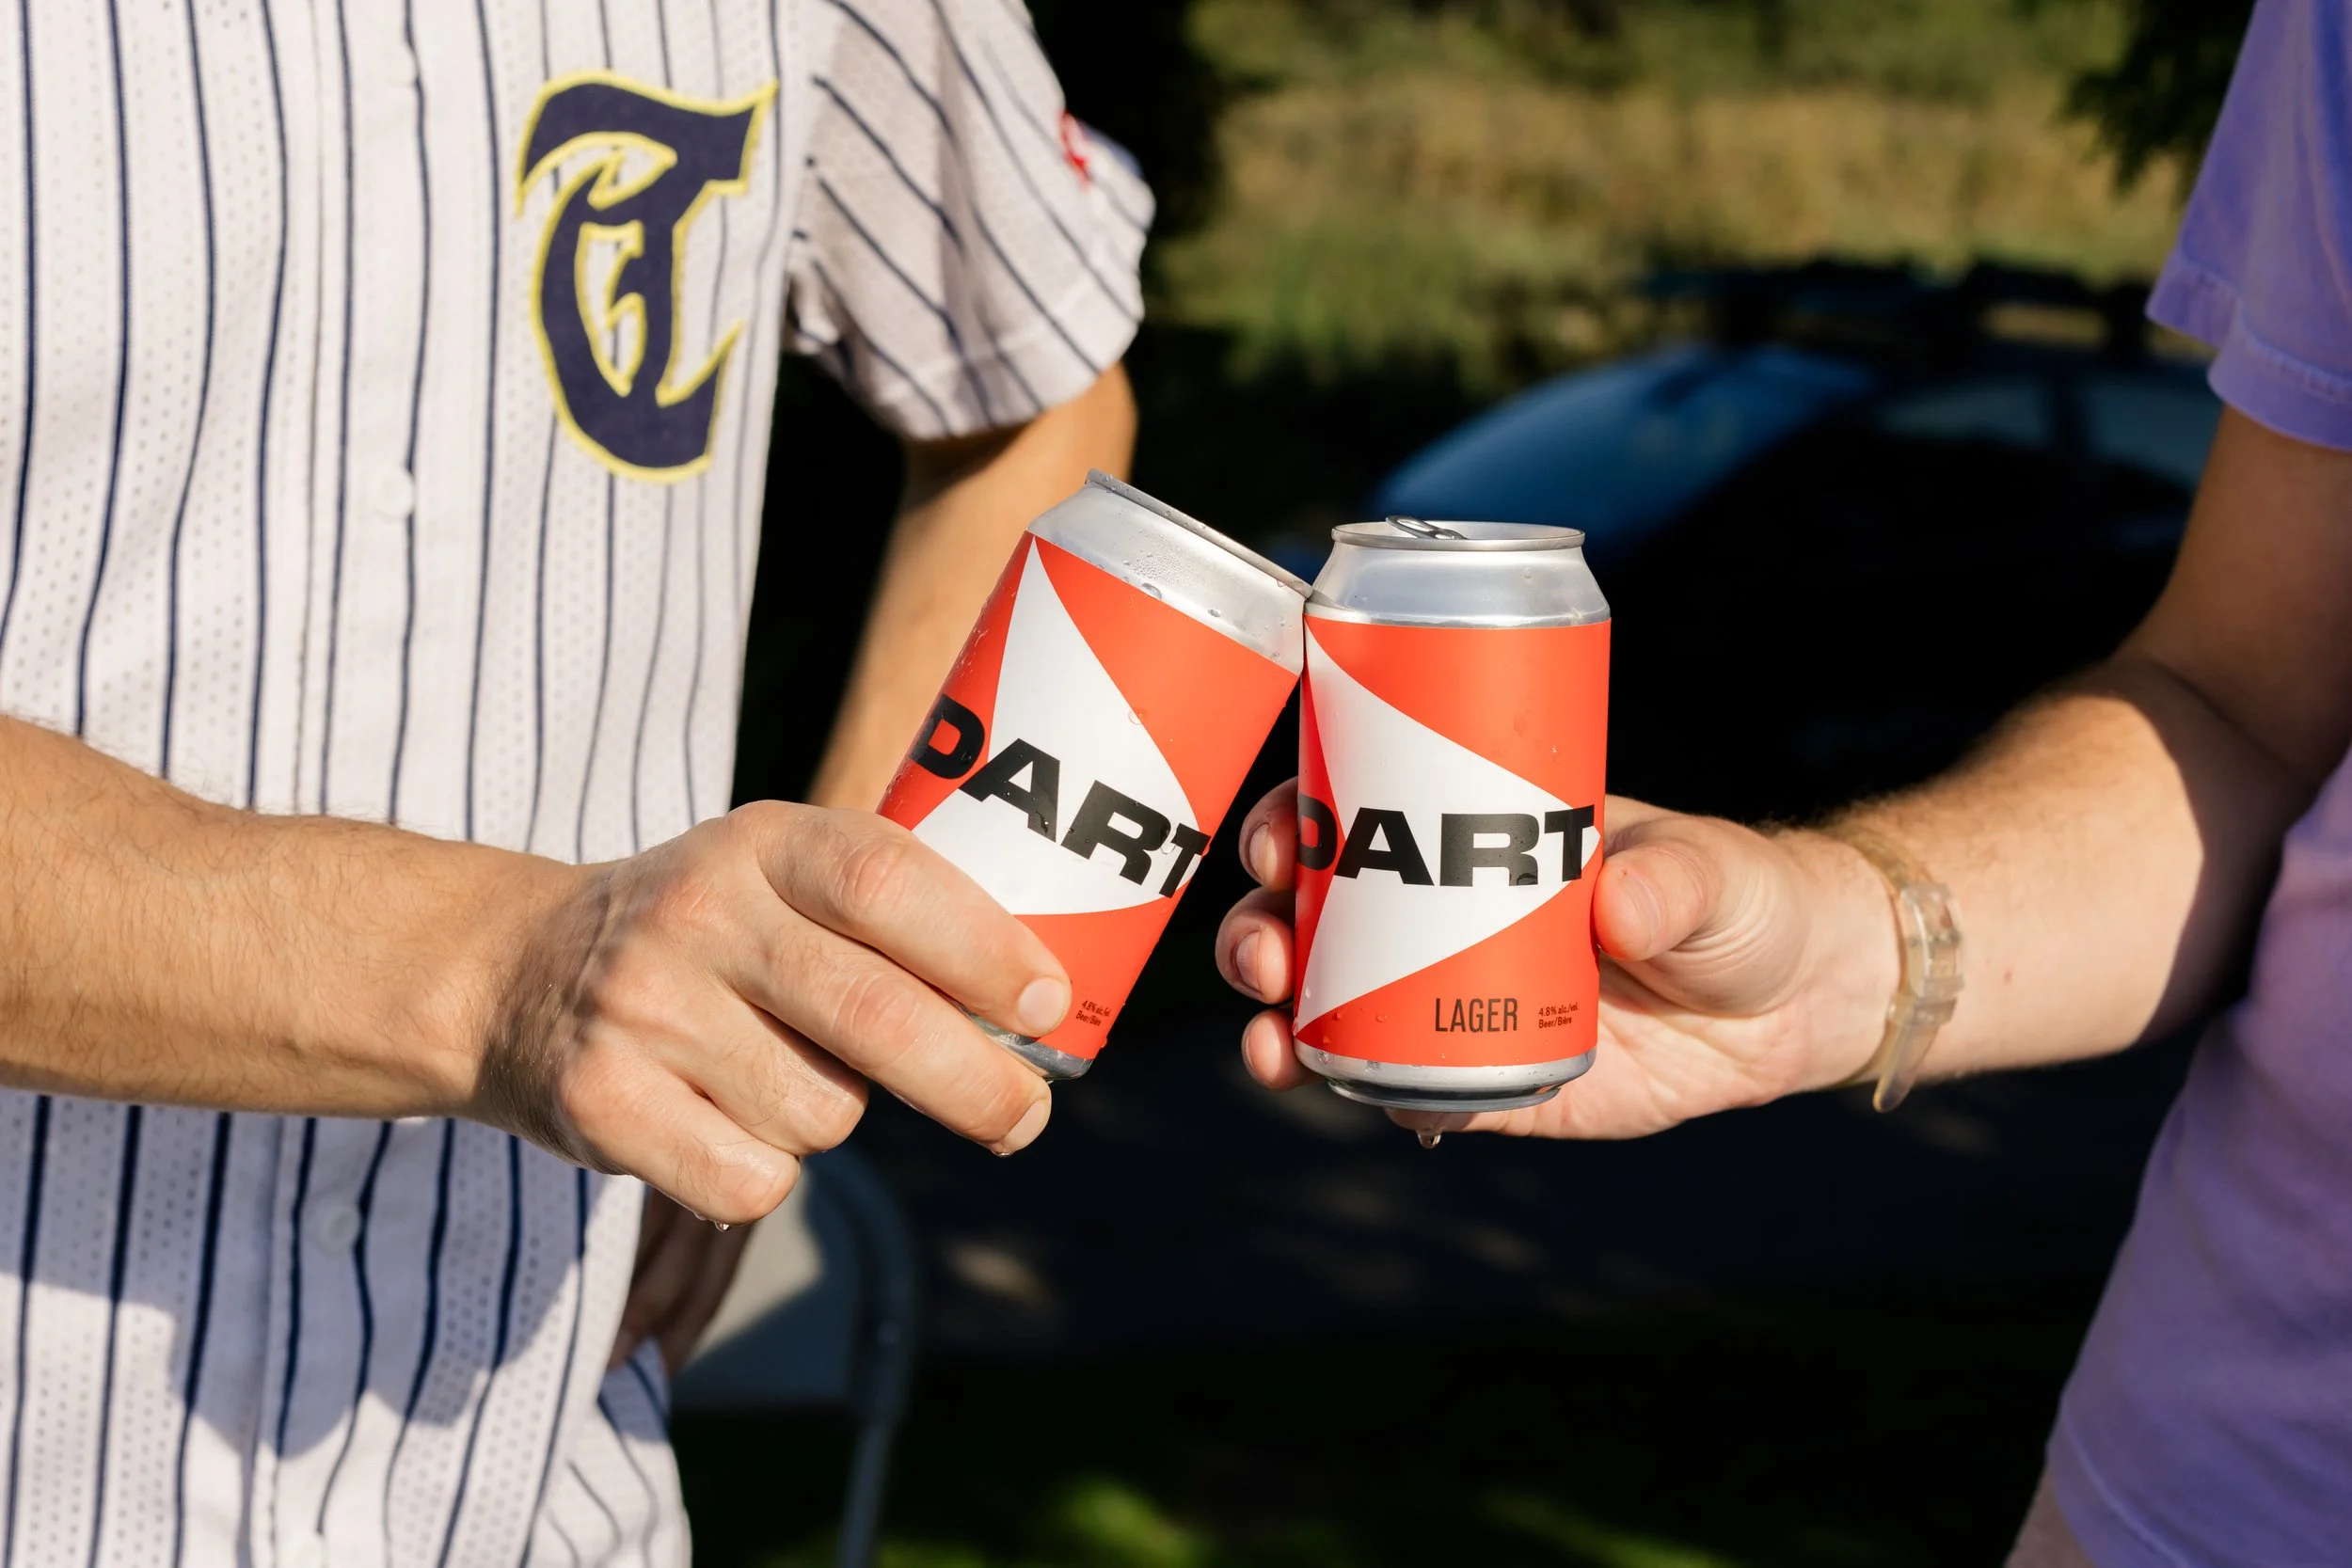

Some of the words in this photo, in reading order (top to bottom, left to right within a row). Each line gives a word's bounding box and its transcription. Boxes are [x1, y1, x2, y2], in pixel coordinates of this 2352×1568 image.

[907, 693, 1211, 898] DART
[1296, 793, 1595, 887] DART
[1435, 997, 1518, 1033] LAGER
[1538, 1006, 1557, 1017] 4.8%
[1538, 1016, 1572, 1028] Beer/Bière
